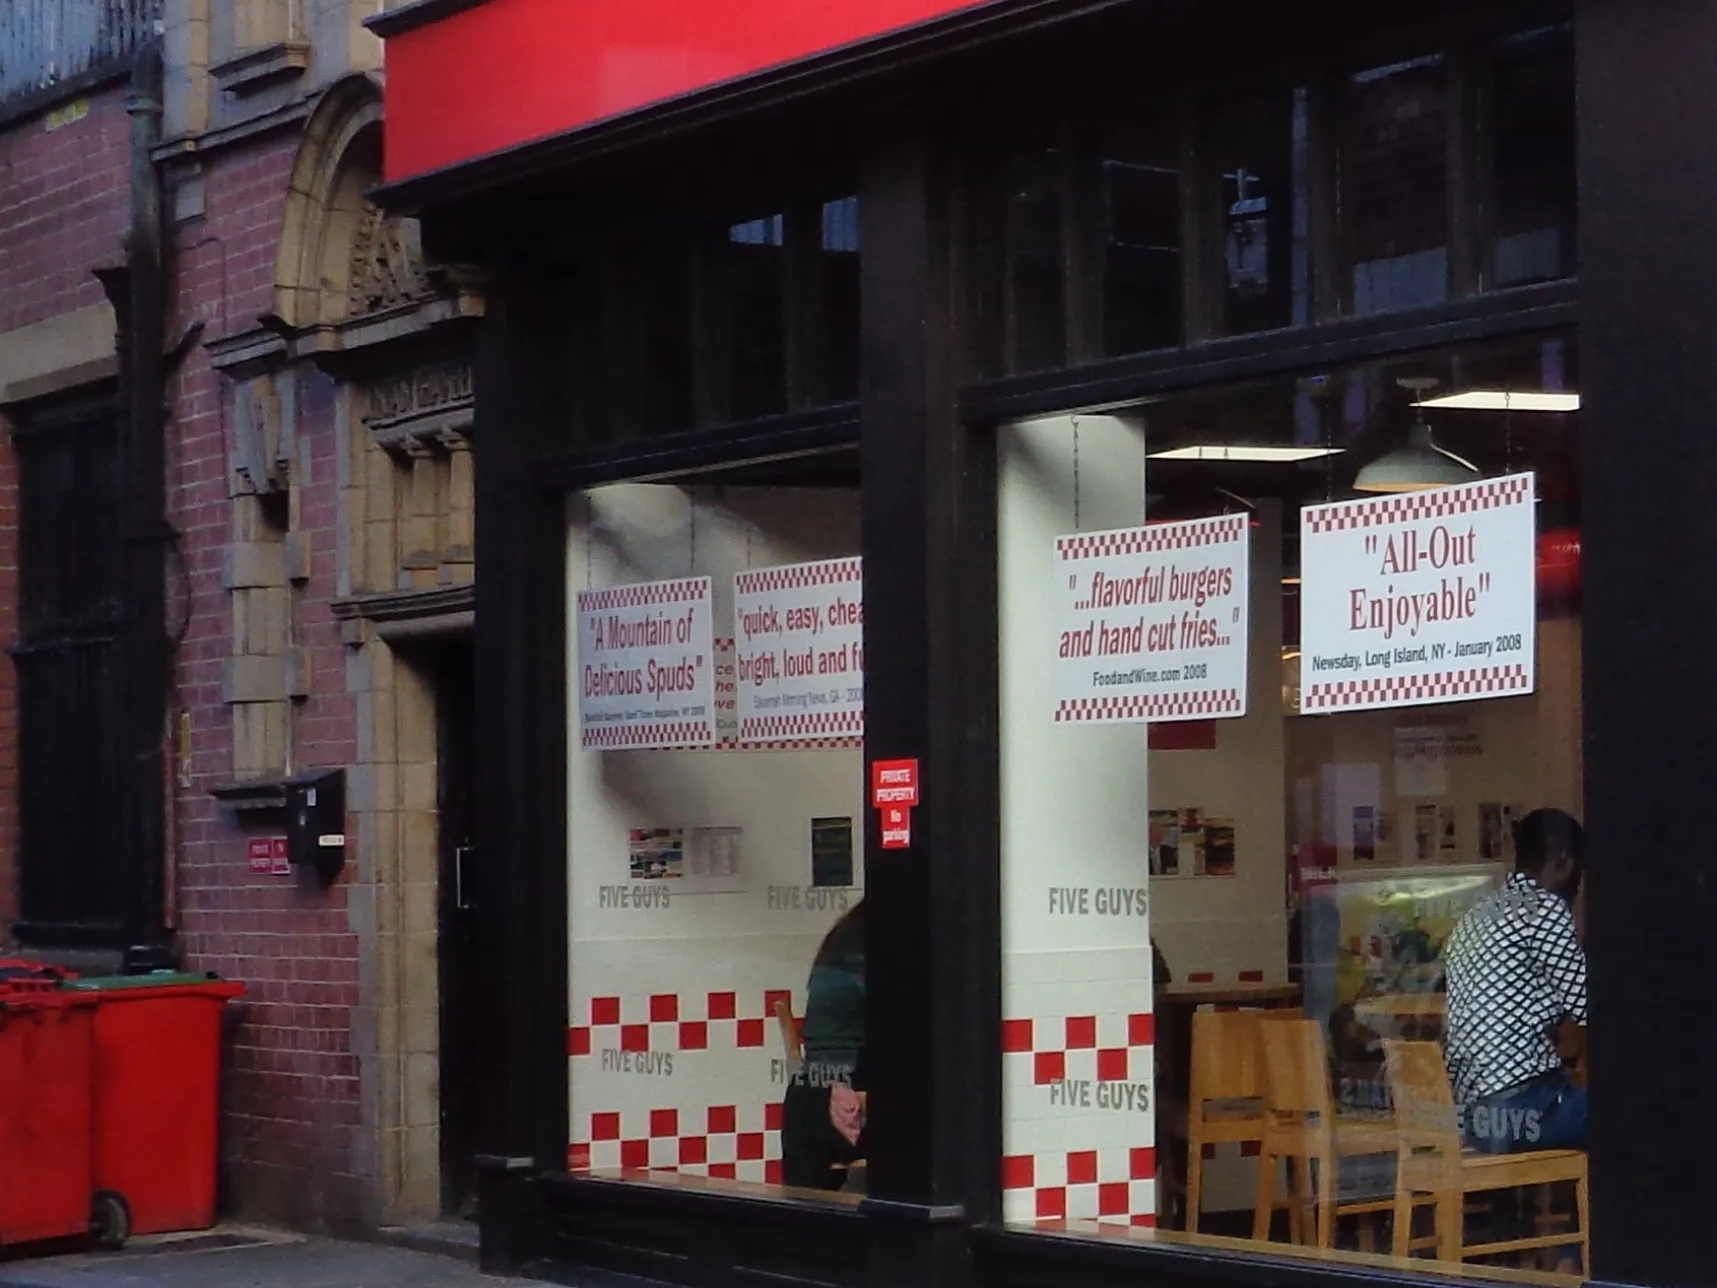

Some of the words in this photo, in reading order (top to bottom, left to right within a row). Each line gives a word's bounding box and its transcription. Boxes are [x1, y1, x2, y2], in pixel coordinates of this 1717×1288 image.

[1365, 525, 1476, 575] "All-Out
[1069, 566, 1165, 610] "...flavorful
[1169, 565, 1232, 607] burgers
[1349, 572, 1491, 639] Enjoyable"
[590, 616, 604, 650] "A
[607, 612, 672, 649] Mountain
[677, 608, 693, 643] of
[738, 604, 782, 641] "quick,
[787, 609, 824, 635] easy,
[1059, 621, 1094, 658] and
[1098, 616, 1144, 655] hand
[1148, 615, 1176, 652] cut
[1180, 607, 1240, 649] fries..."
[739, 649, 780, 686] bright,
[783, 647, 813, 677] loud
[819, 644, 847, 673] and
[1312, 655, 1362, 672] Newsday,
[1366, 651, 1391, 668] Long
[1394, 646, 1428, 664] Island,
[1431, 643, 1446, 659] NY
[1454, 640, 1494, 658] January
[1496, 634, 1522, 652] 2008
[584, 663, 642, 698] Delicious
[647, 655, 703, 702] Spuds"
[1092, 667, 1180, 687] FoodandWine.com
[1184, 664, 1207, 680] 2008
[600, 886, 628, 908] FIVE
[633, 886, 671, 909] GUYS
[768, 886, 800, 910] FIVE
[806, 888, 849, 911] GUYS
[1049, 887, 1089, 915] FIVE
[1096, 888, 1148, 916] GUYS
[602, 1049, 631, 1074] FIVE
[635, 1052, 673, 1076] GUYS
[808, 1063, 852, 1089] GUYS
[1050, 1079, 1090, 1107] FIVE
[1096, 1082, 1149, 1112] GUYS
[1473, 1105, 1543, 1142] GUYS
